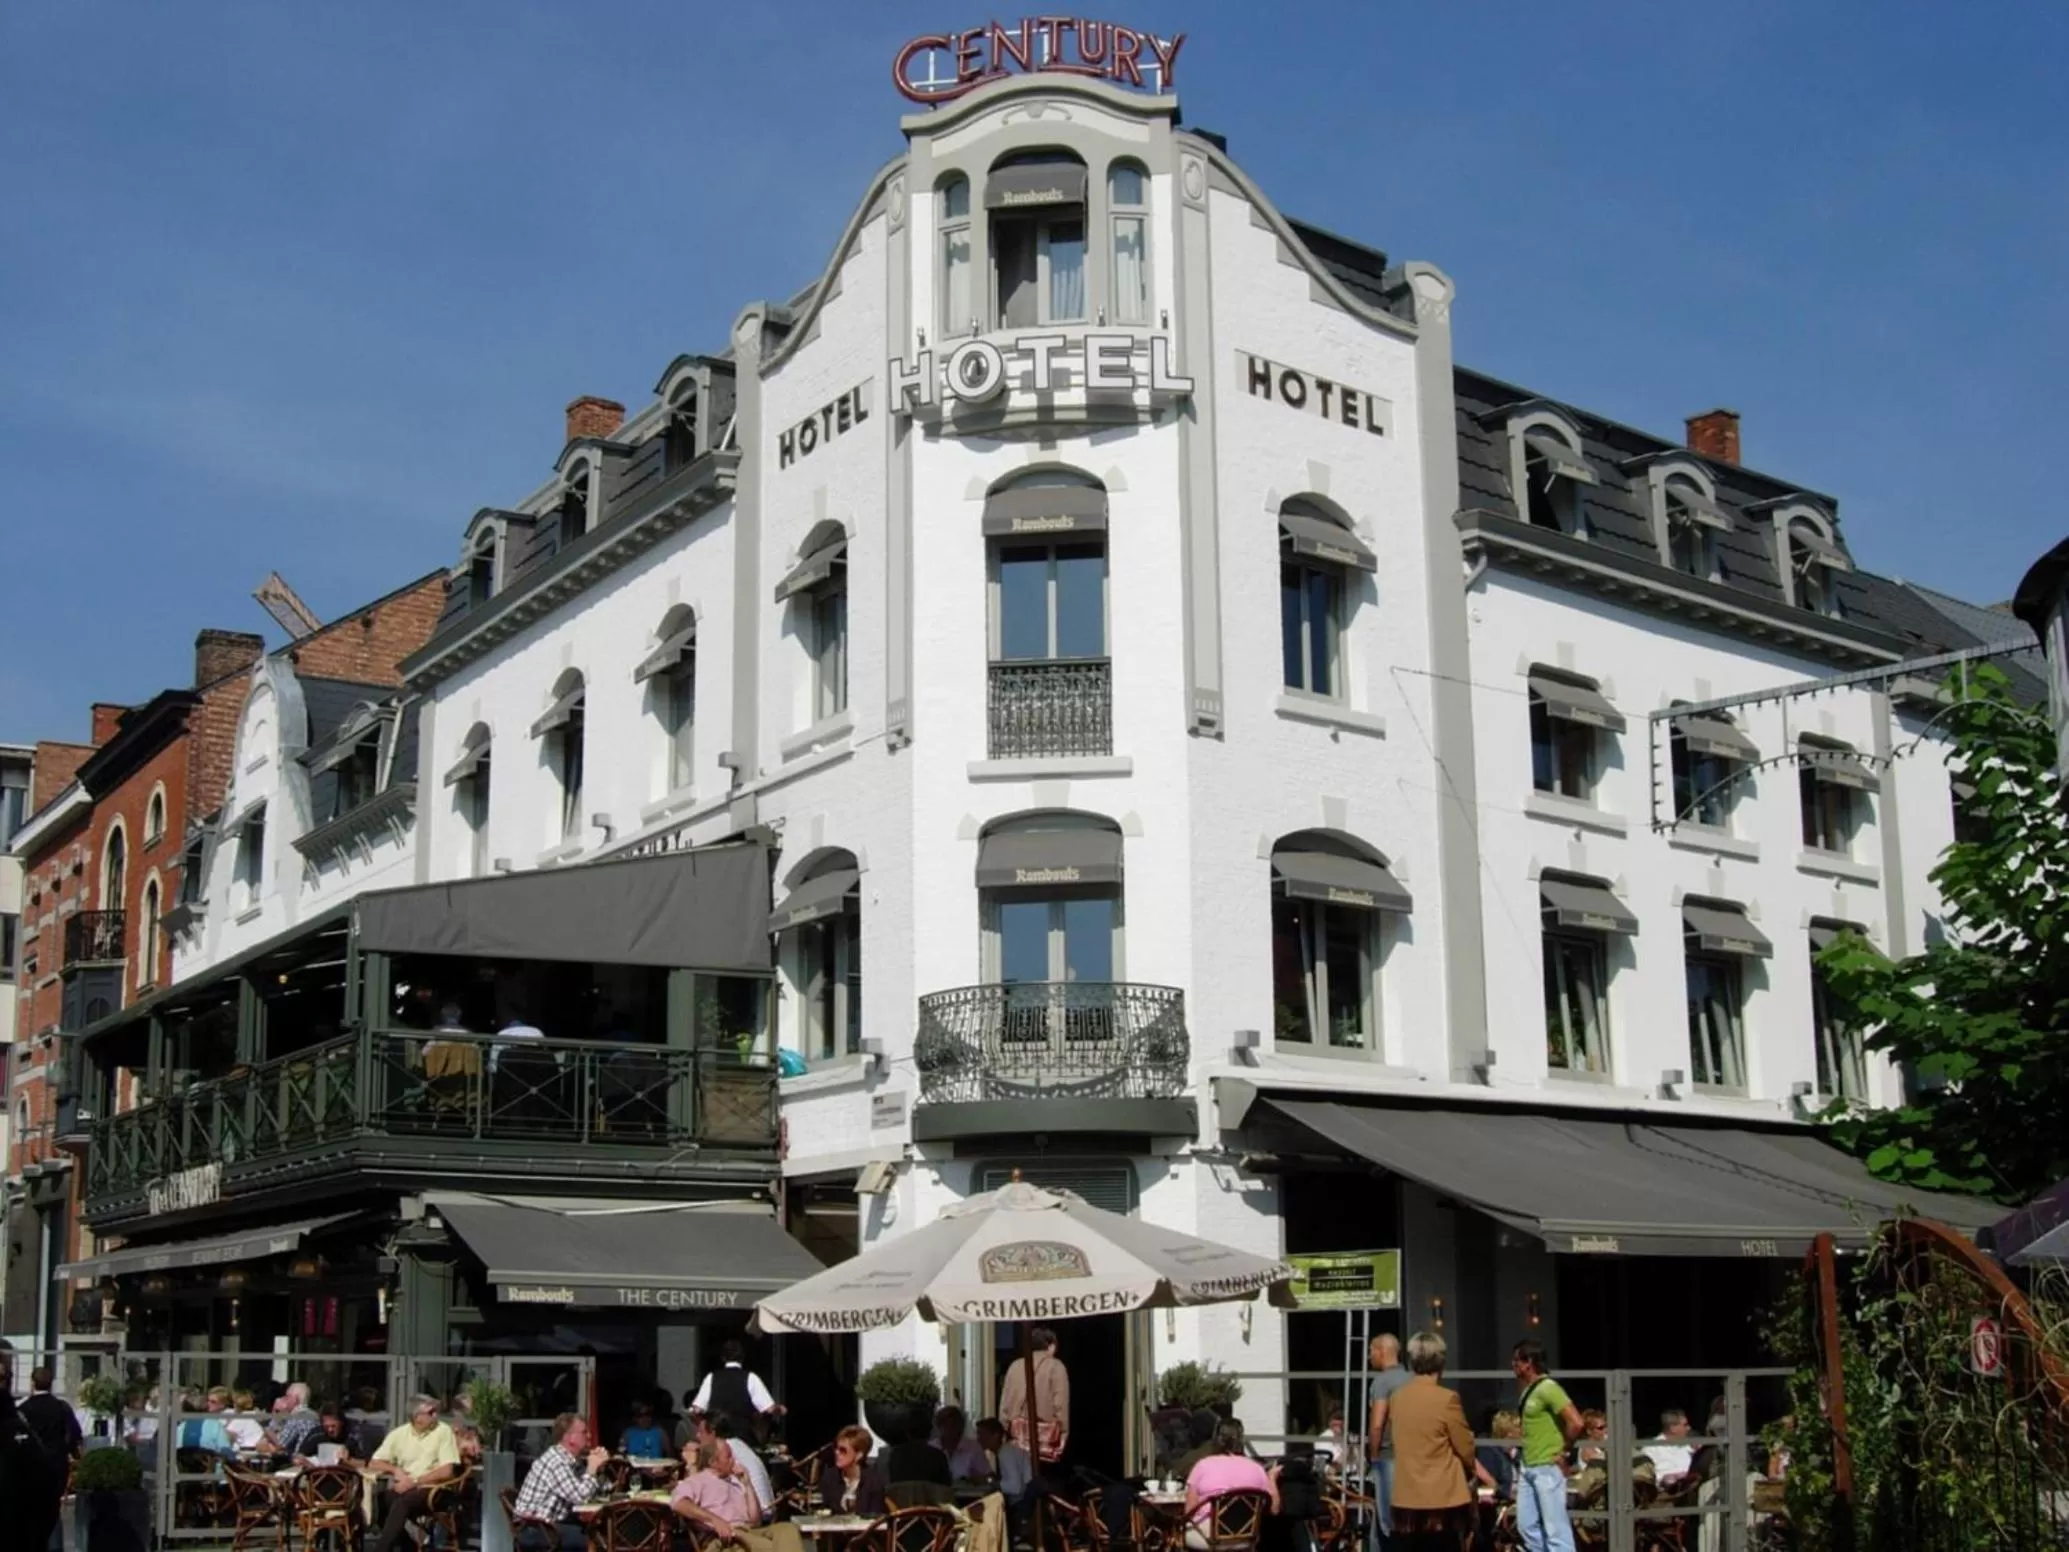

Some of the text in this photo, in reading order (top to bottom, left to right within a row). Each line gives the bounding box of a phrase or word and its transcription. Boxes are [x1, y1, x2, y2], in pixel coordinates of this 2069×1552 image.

[892, 15, 1187, 105] CENTURY
[889, 334, 1195, 414] HOTEL
[1248, 355, 1384, 436] HOTEL
[780, 385, 869, 470] HOTEL
[1741, 1240, 1779, 1256] HOTEL
[617, 1288, 650, 1305] THE
[656, 1289, 738, 1306] CENTURY
[964, 1292, 1128, 1319] GRIMBERGEN
